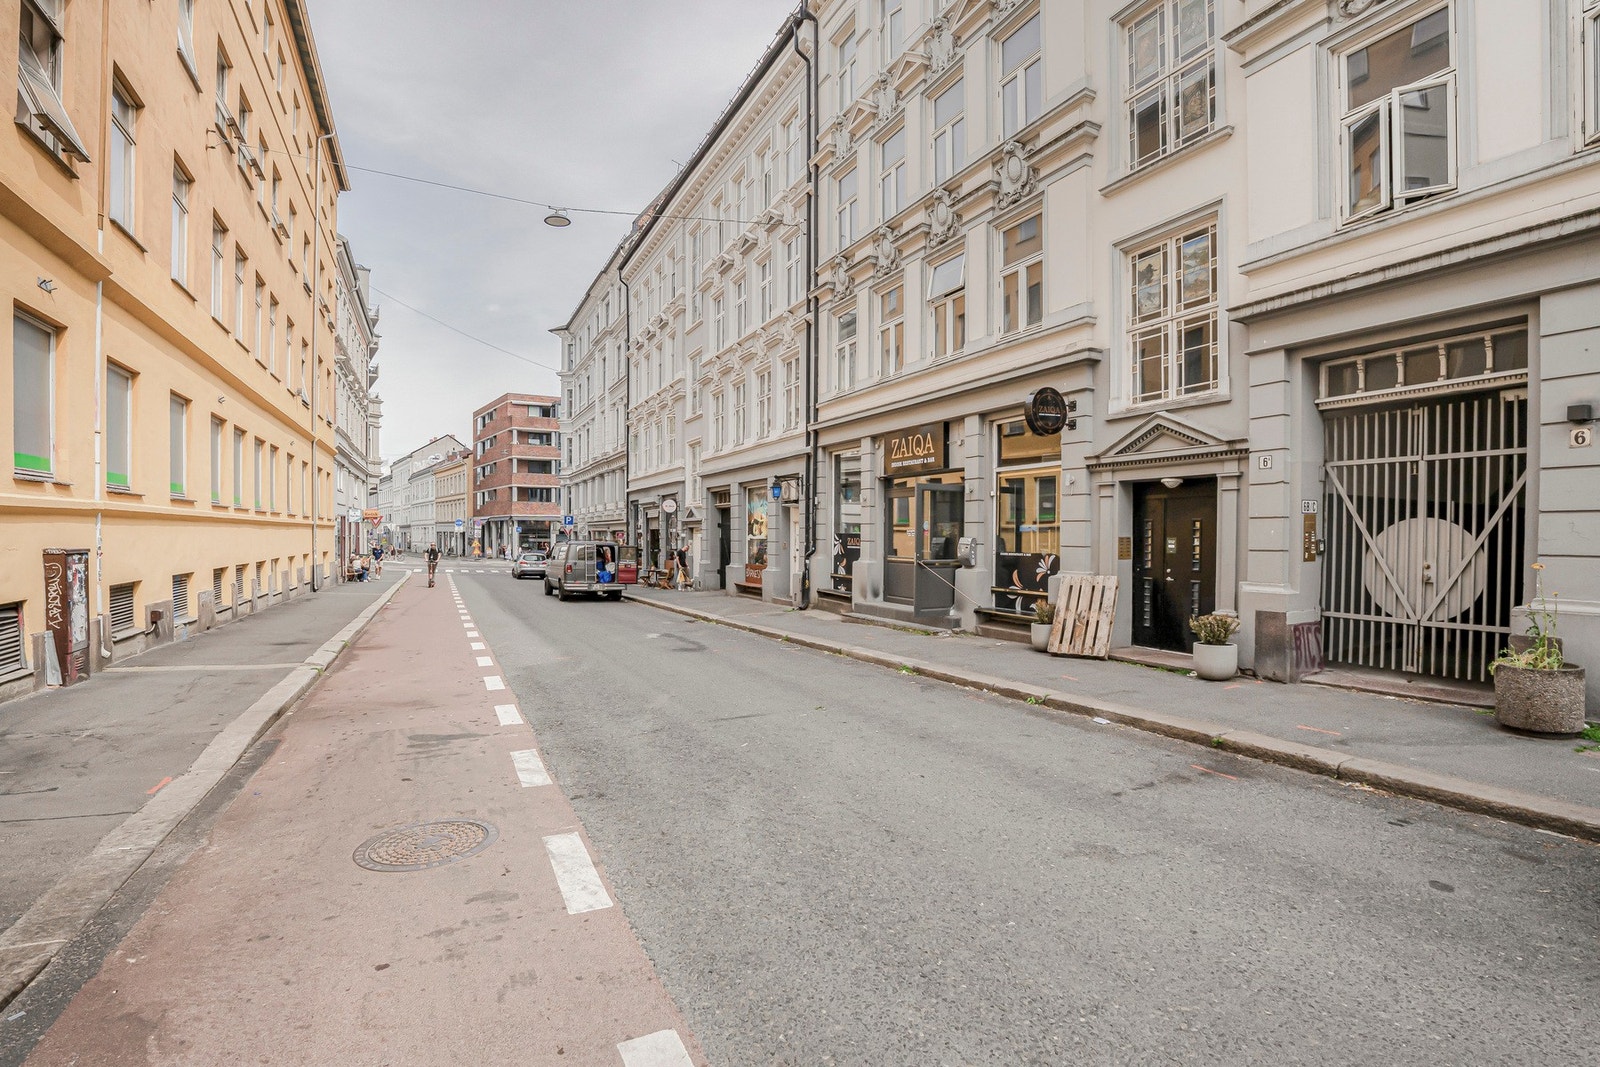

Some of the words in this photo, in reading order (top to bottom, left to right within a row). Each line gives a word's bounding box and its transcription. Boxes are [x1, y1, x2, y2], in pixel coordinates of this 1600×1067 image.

[1039, 405, 1061, 414] ZAIQA
[1574, 430, 1586, 445] 6
[891, 432, 935, 459] ZAIQA
[846, 537, 861, 546] ZAIQ
